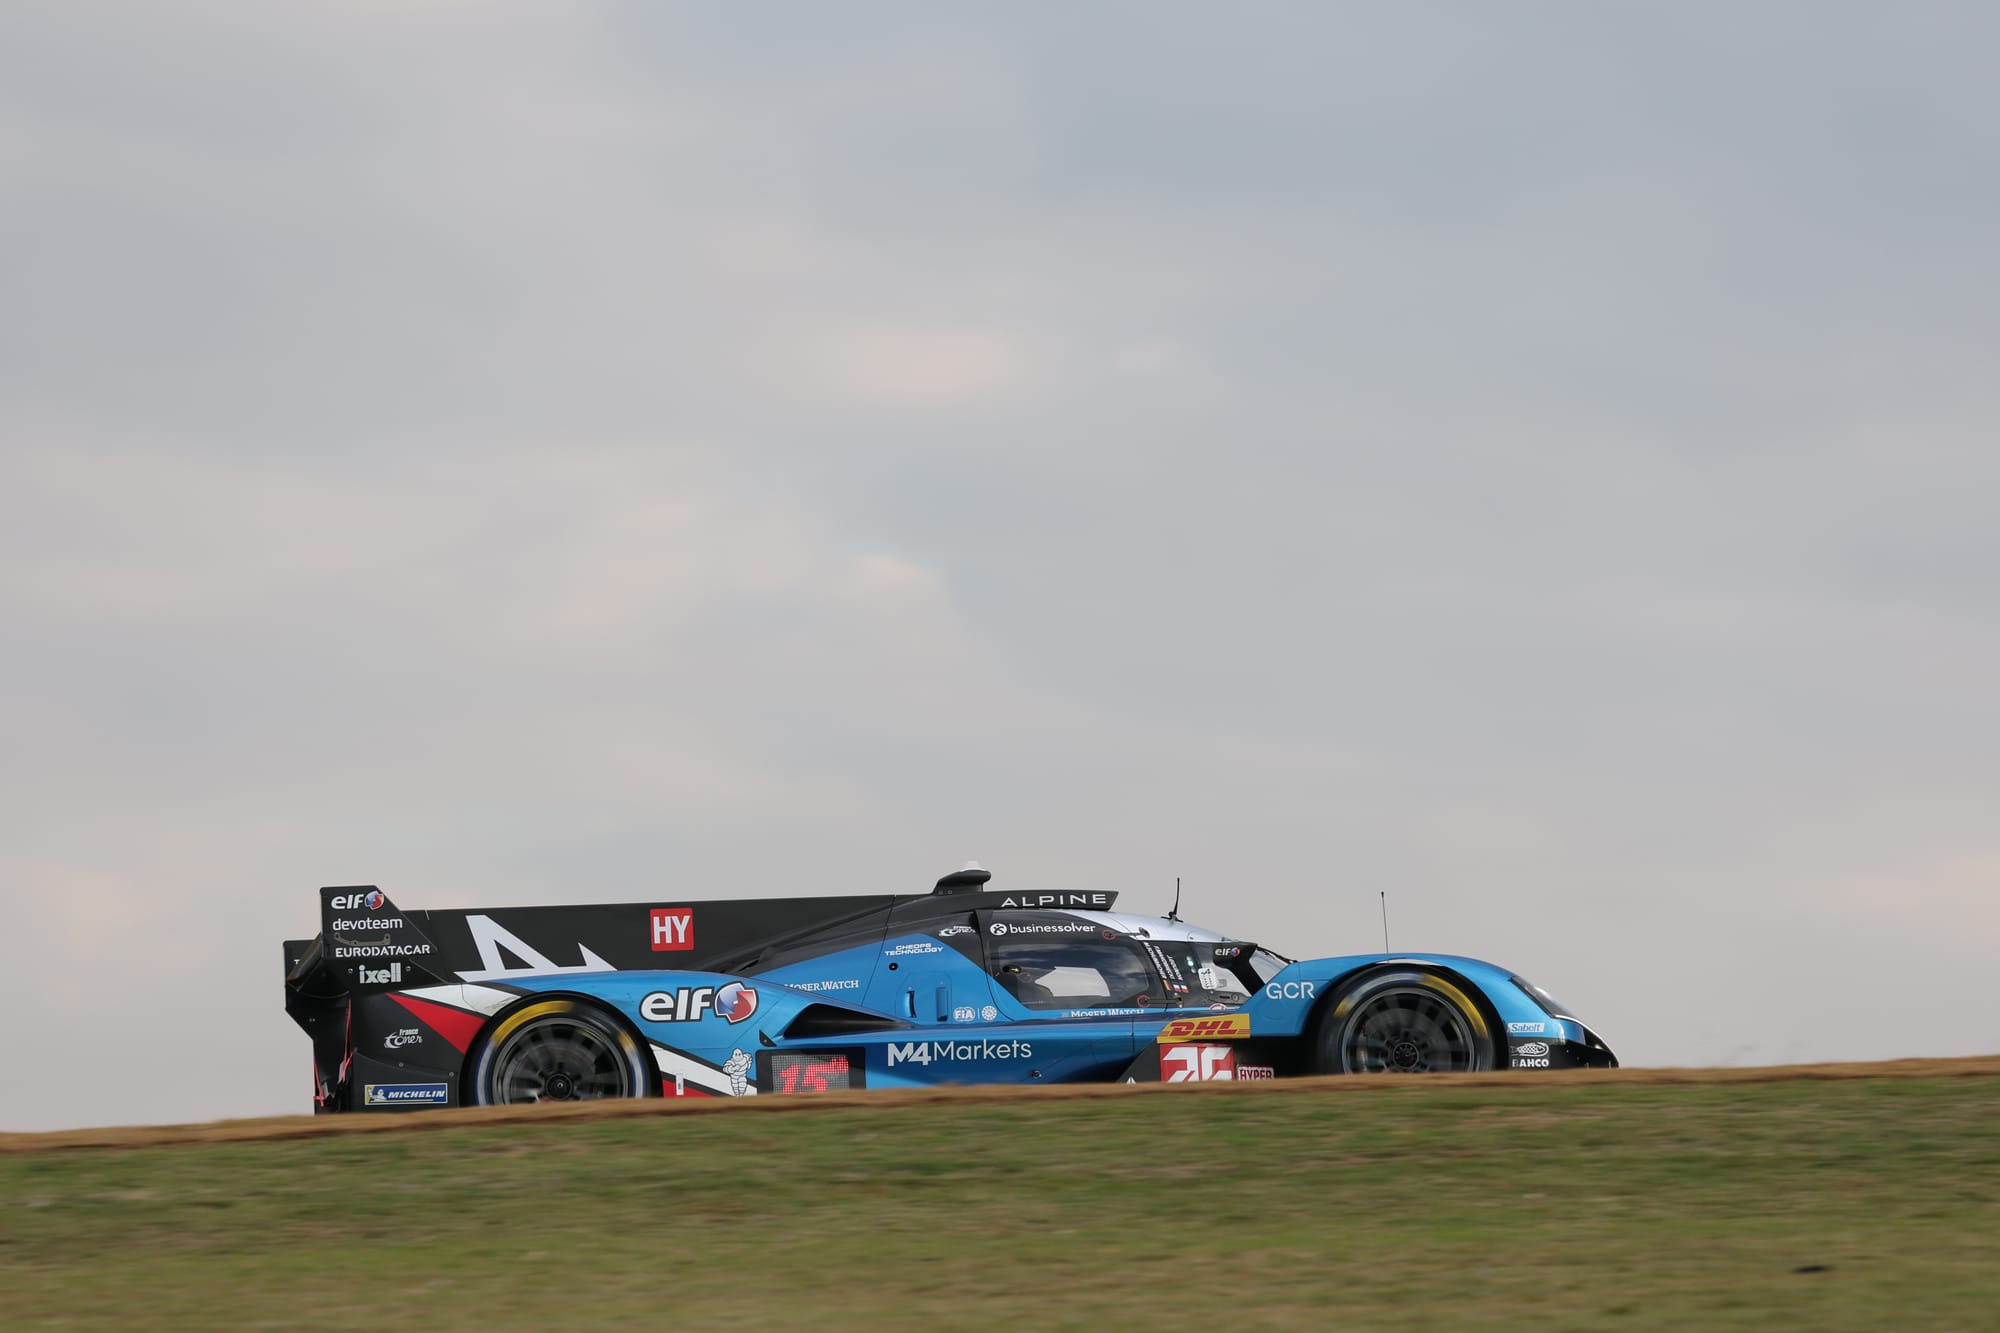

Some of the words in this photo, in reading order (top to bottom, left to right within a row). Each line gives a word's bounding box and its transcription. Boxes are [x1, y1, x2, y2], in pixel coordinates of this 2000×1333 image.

[331, 894, 365, 910] elf
[1000, 893, 1107, 908] ALPINE
[332, 917, 403, 931] devoteam
[652, 915, 691, 944] HY
[1009, 923, 1096, 934] businessolver
[335, 944, 431, 958] EURODATACAR
[884, 946, 944, 956] TECHNOLOGY
[895, 942, 932, 951] CHEOPS
[358, 962, 402, 984] ixell
[1265, 981, 1316, 1000] GCR
[640, 987, 716, 1022] elf
[1168, 1020, 1238, 1037] DHL
[1511, 1023, 1541, 1032] Sabelt
[1239, 1069, 1273, 1081] HYPER
[387, 1090, 446, 1099] MICHELIN
